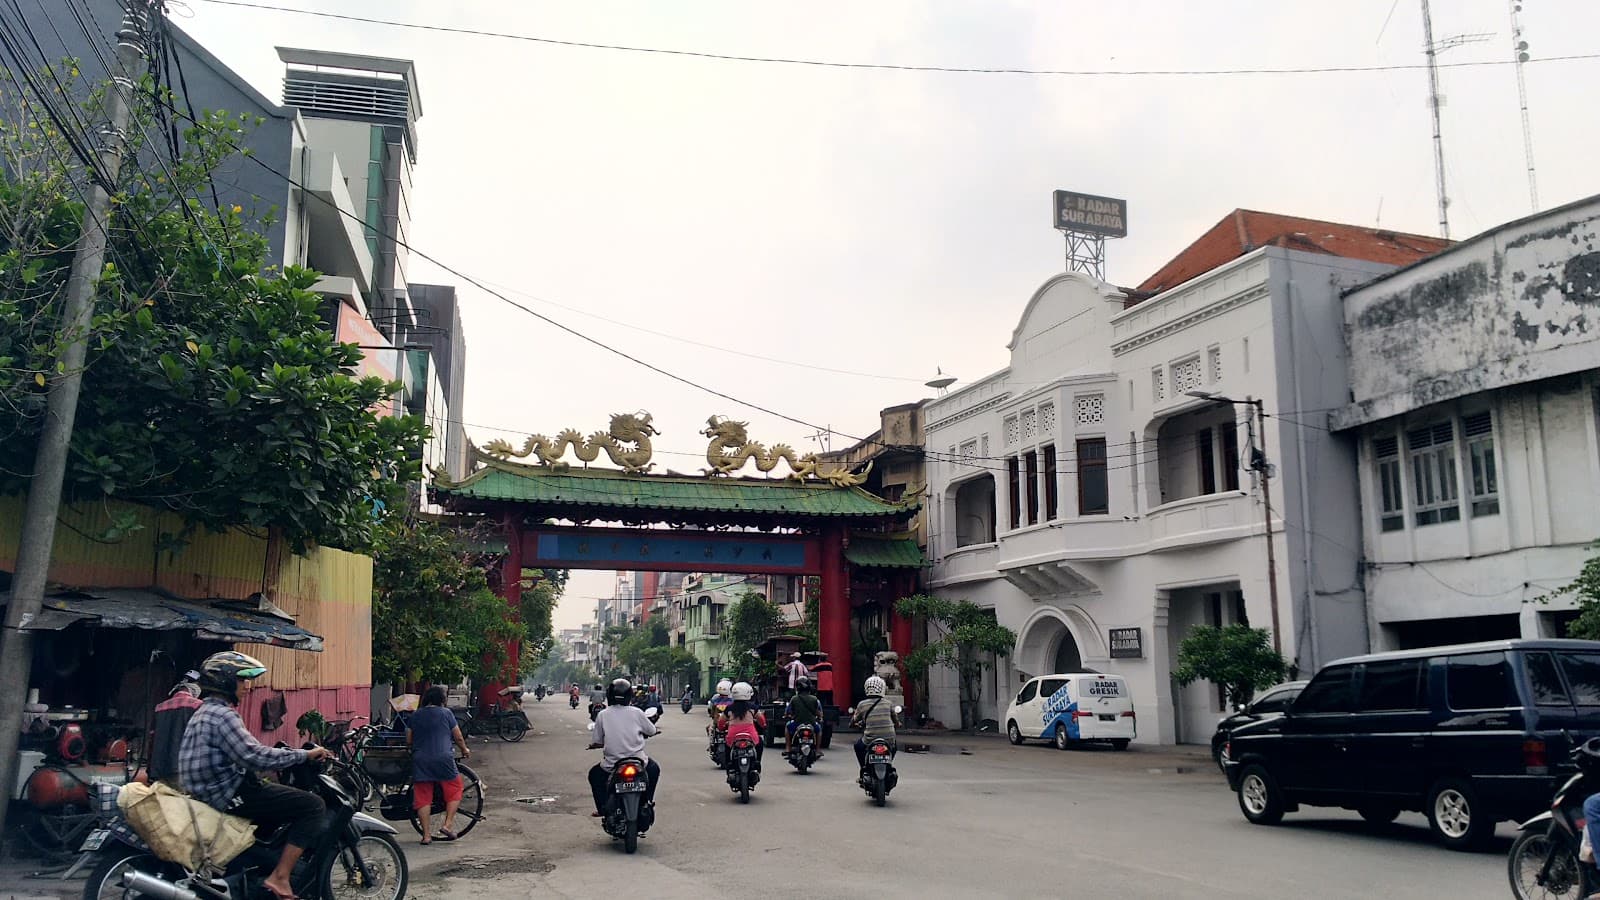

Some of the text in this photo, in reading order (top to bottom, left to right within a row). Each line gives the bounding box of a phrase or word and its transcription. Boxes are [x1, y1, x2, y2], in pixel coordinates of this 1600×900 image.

[1077, 197, 1120, 215] RADAR
[1061, 208, 1123, 229] SURABAYA
[1118, 629, 1137, 640] RADAR
[1047, 686, 1069, 709] RADAR
[1089, 687, 1119, 695] GRESIK
